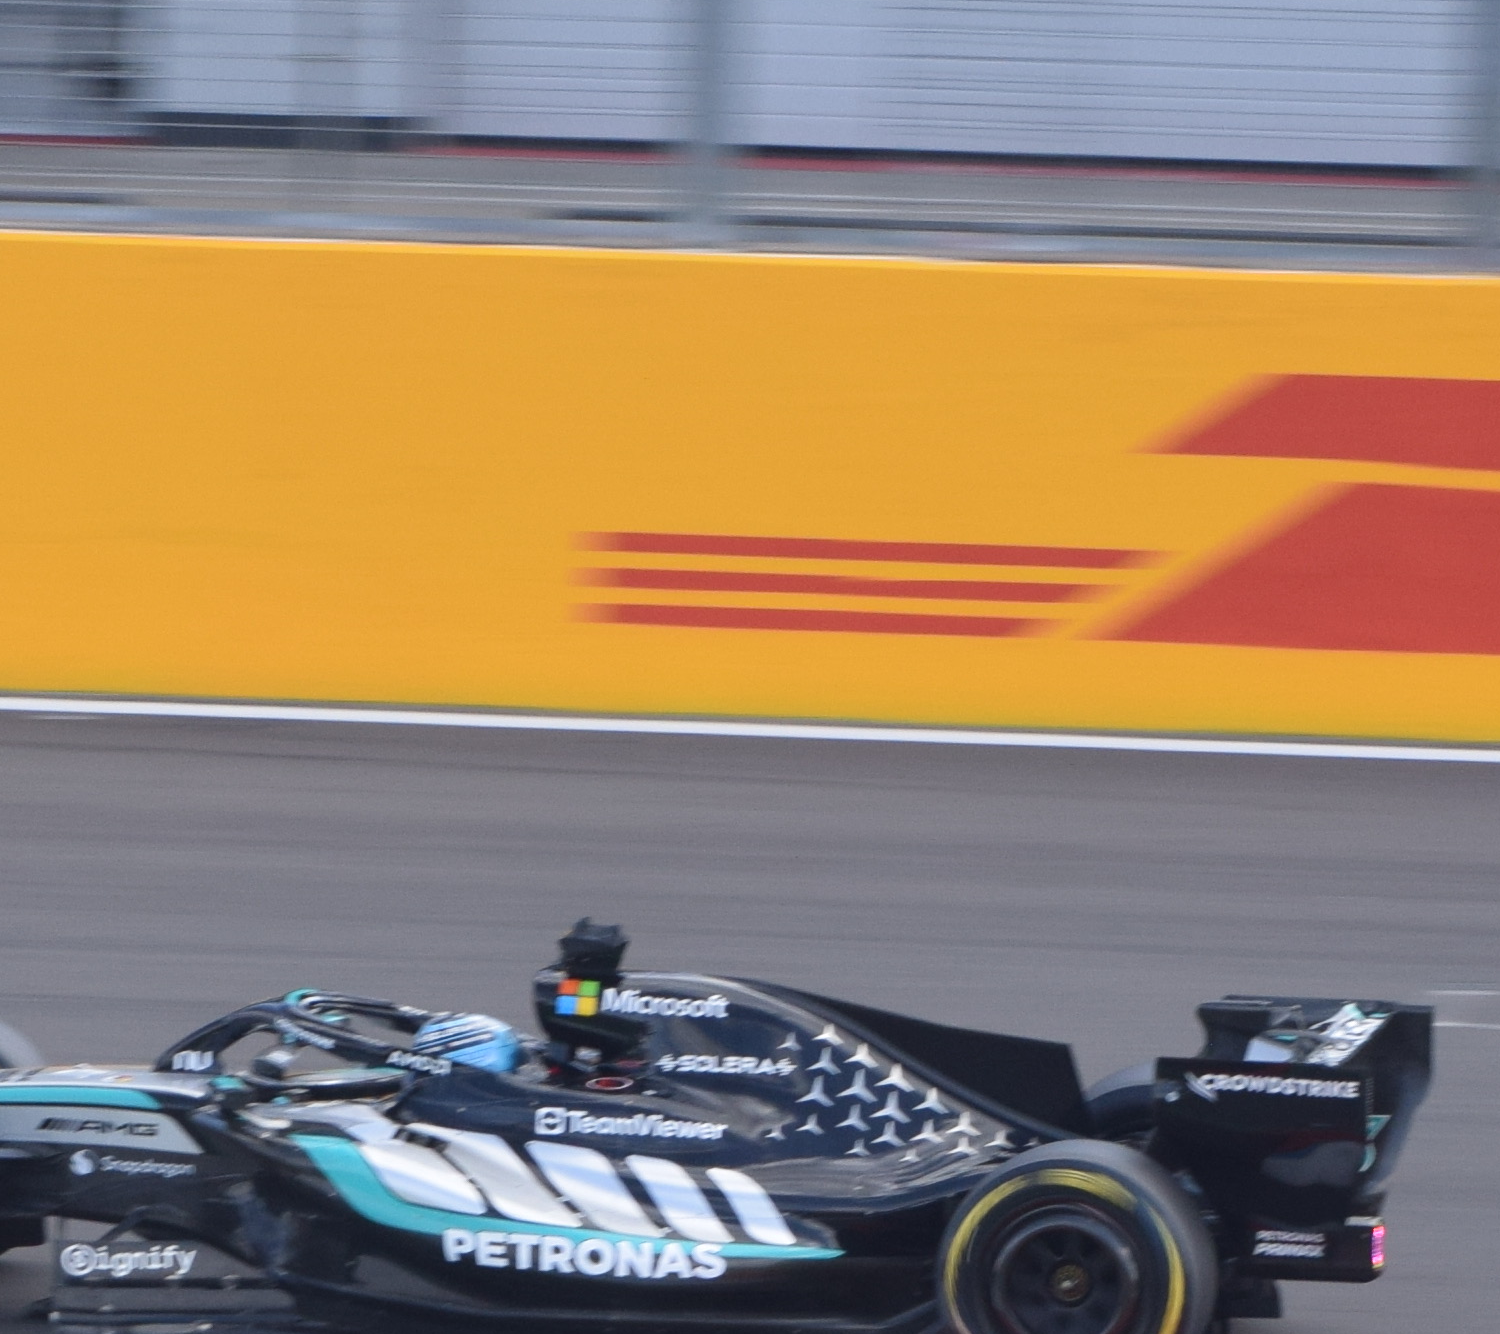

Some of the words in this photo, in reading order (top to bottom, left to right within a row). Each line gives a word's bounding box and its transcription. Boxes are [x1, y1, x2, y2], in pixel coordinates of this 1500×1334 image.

[600, 987, 730, 1019] Microsoft
[1198, 1073, 1361, 1099] CROWDSTRIKE
[566, 1110, 730, 1141] TeamViewer
[441, 1228, 728, 1280] PETRONAS
